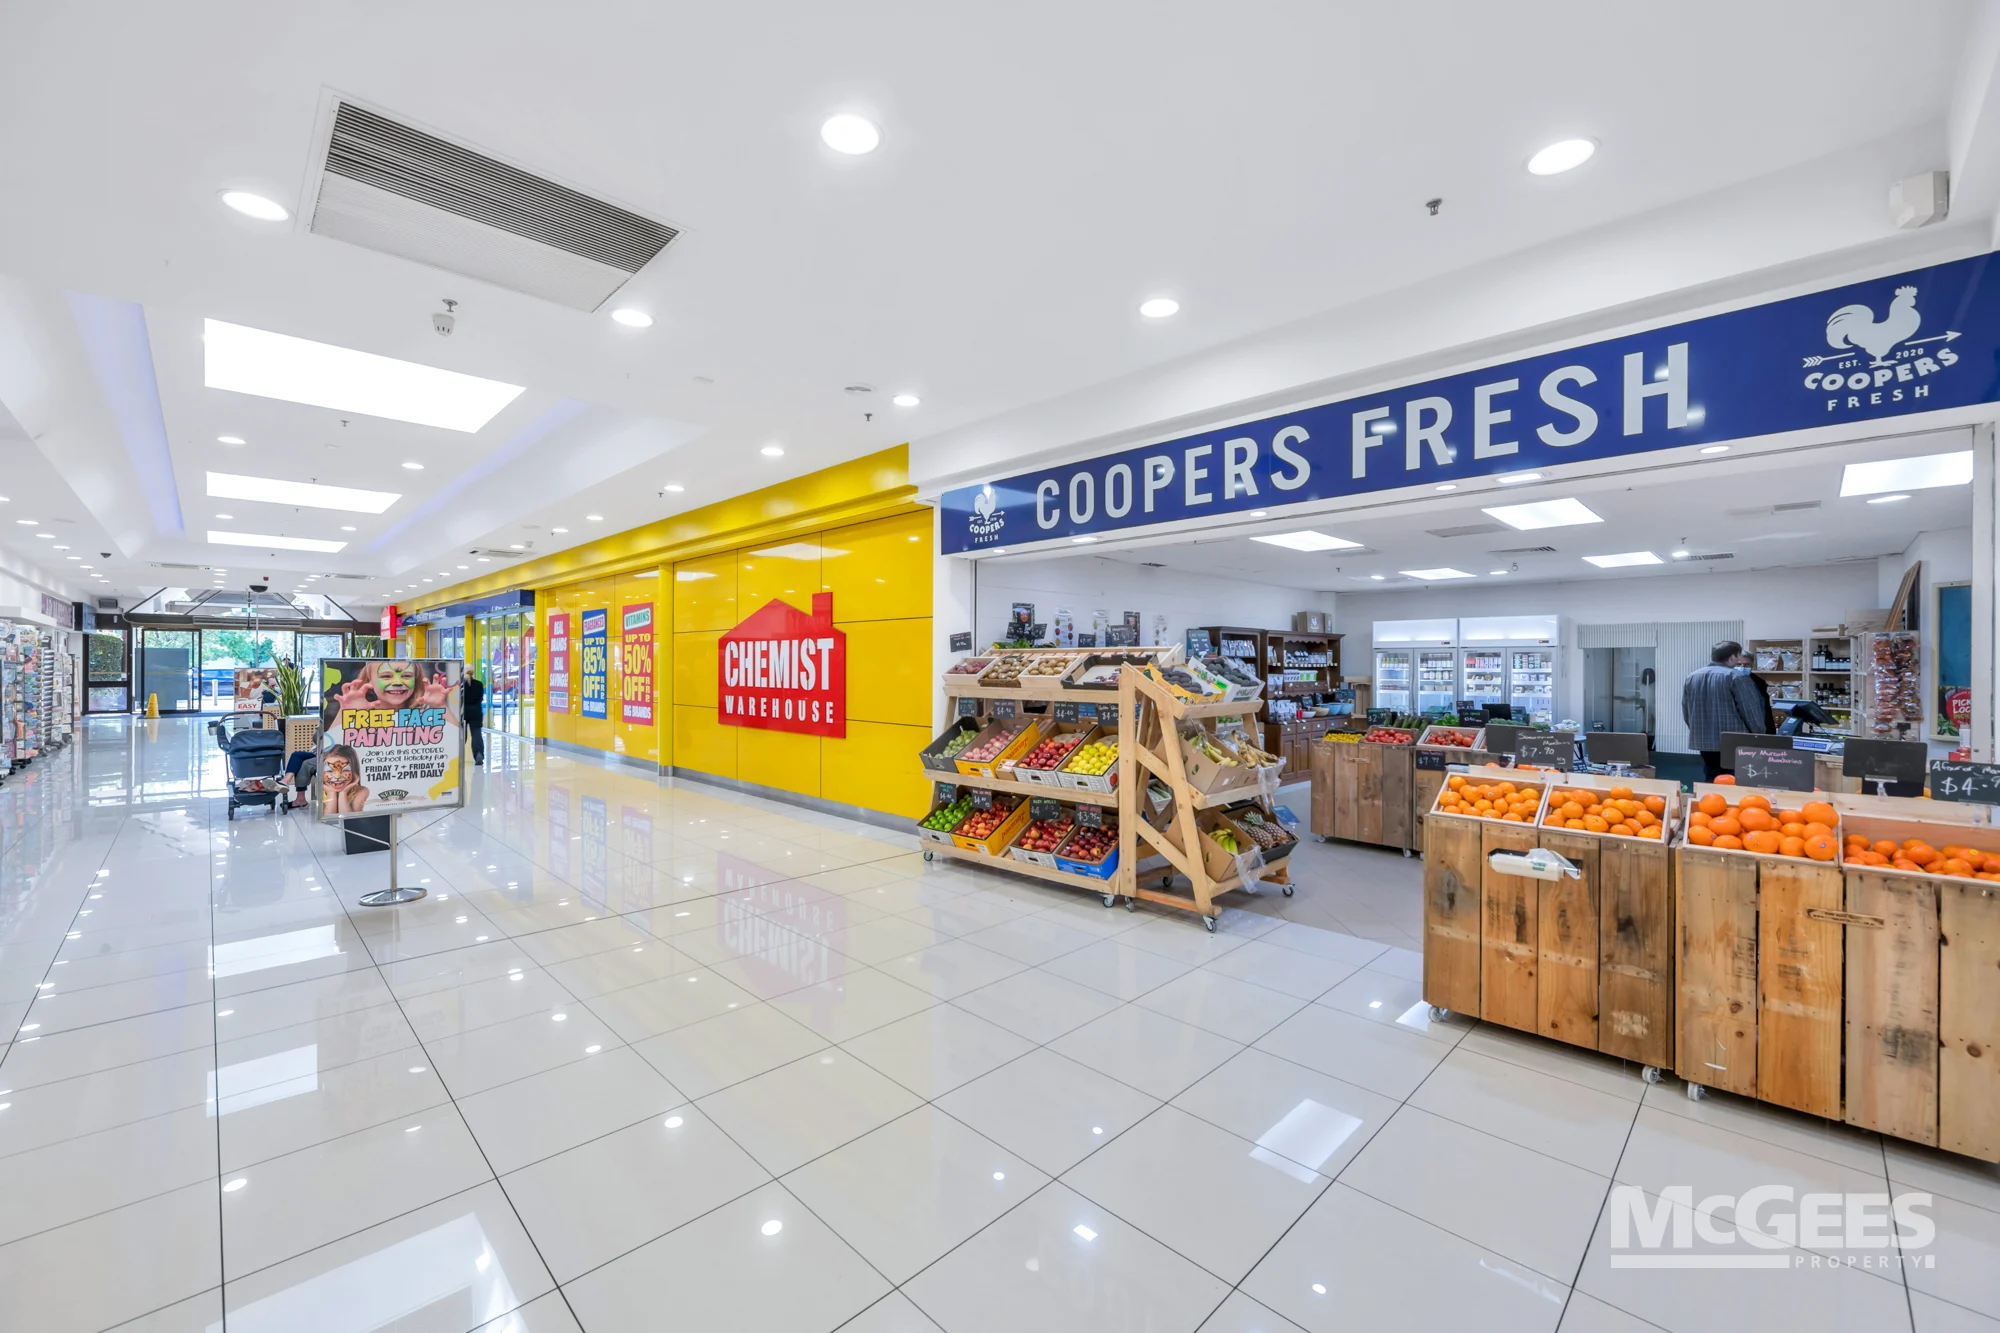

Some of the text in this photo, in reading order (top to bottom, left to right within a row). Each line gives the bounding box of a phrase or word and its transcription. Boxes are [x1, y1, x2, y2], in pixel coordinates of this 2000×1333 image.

[1895, 348, 1924, 359] 2020
[1804, 347, 1959, 391] COOPERS
[1839, 360, 1862, 369] EST.
[1827, 385, 1929, 412] FRESH
[1035, 341, 1689, 530] COOPERS FRESH
[969, 518, 1005, 535] COOPERS
[974, 534, 999, 543] FRESH
[625, 610, 651, 627] VITAMINS
[595, 637, 605, 645] TO
[625, 633, 651, 642] UP TO
[583, 646, 605, 674] 85%
[623, 643, 652, 674] 50%
[724, 637, 835, 691] CHEMIST
[583, 675, 600, 699] OFF
[623, 675, 645, 702] OFF
[342, 707, 446, 730] FREE FACE
[724, 694, 834, 724] WAREHOUSE
[1952, 706, 1971, 714] LOC
[365, 765, 392, 773] FRIDAY
[409, 762, 435, 770] FRIDAY
[420, 769, 445, 779] DAILY
